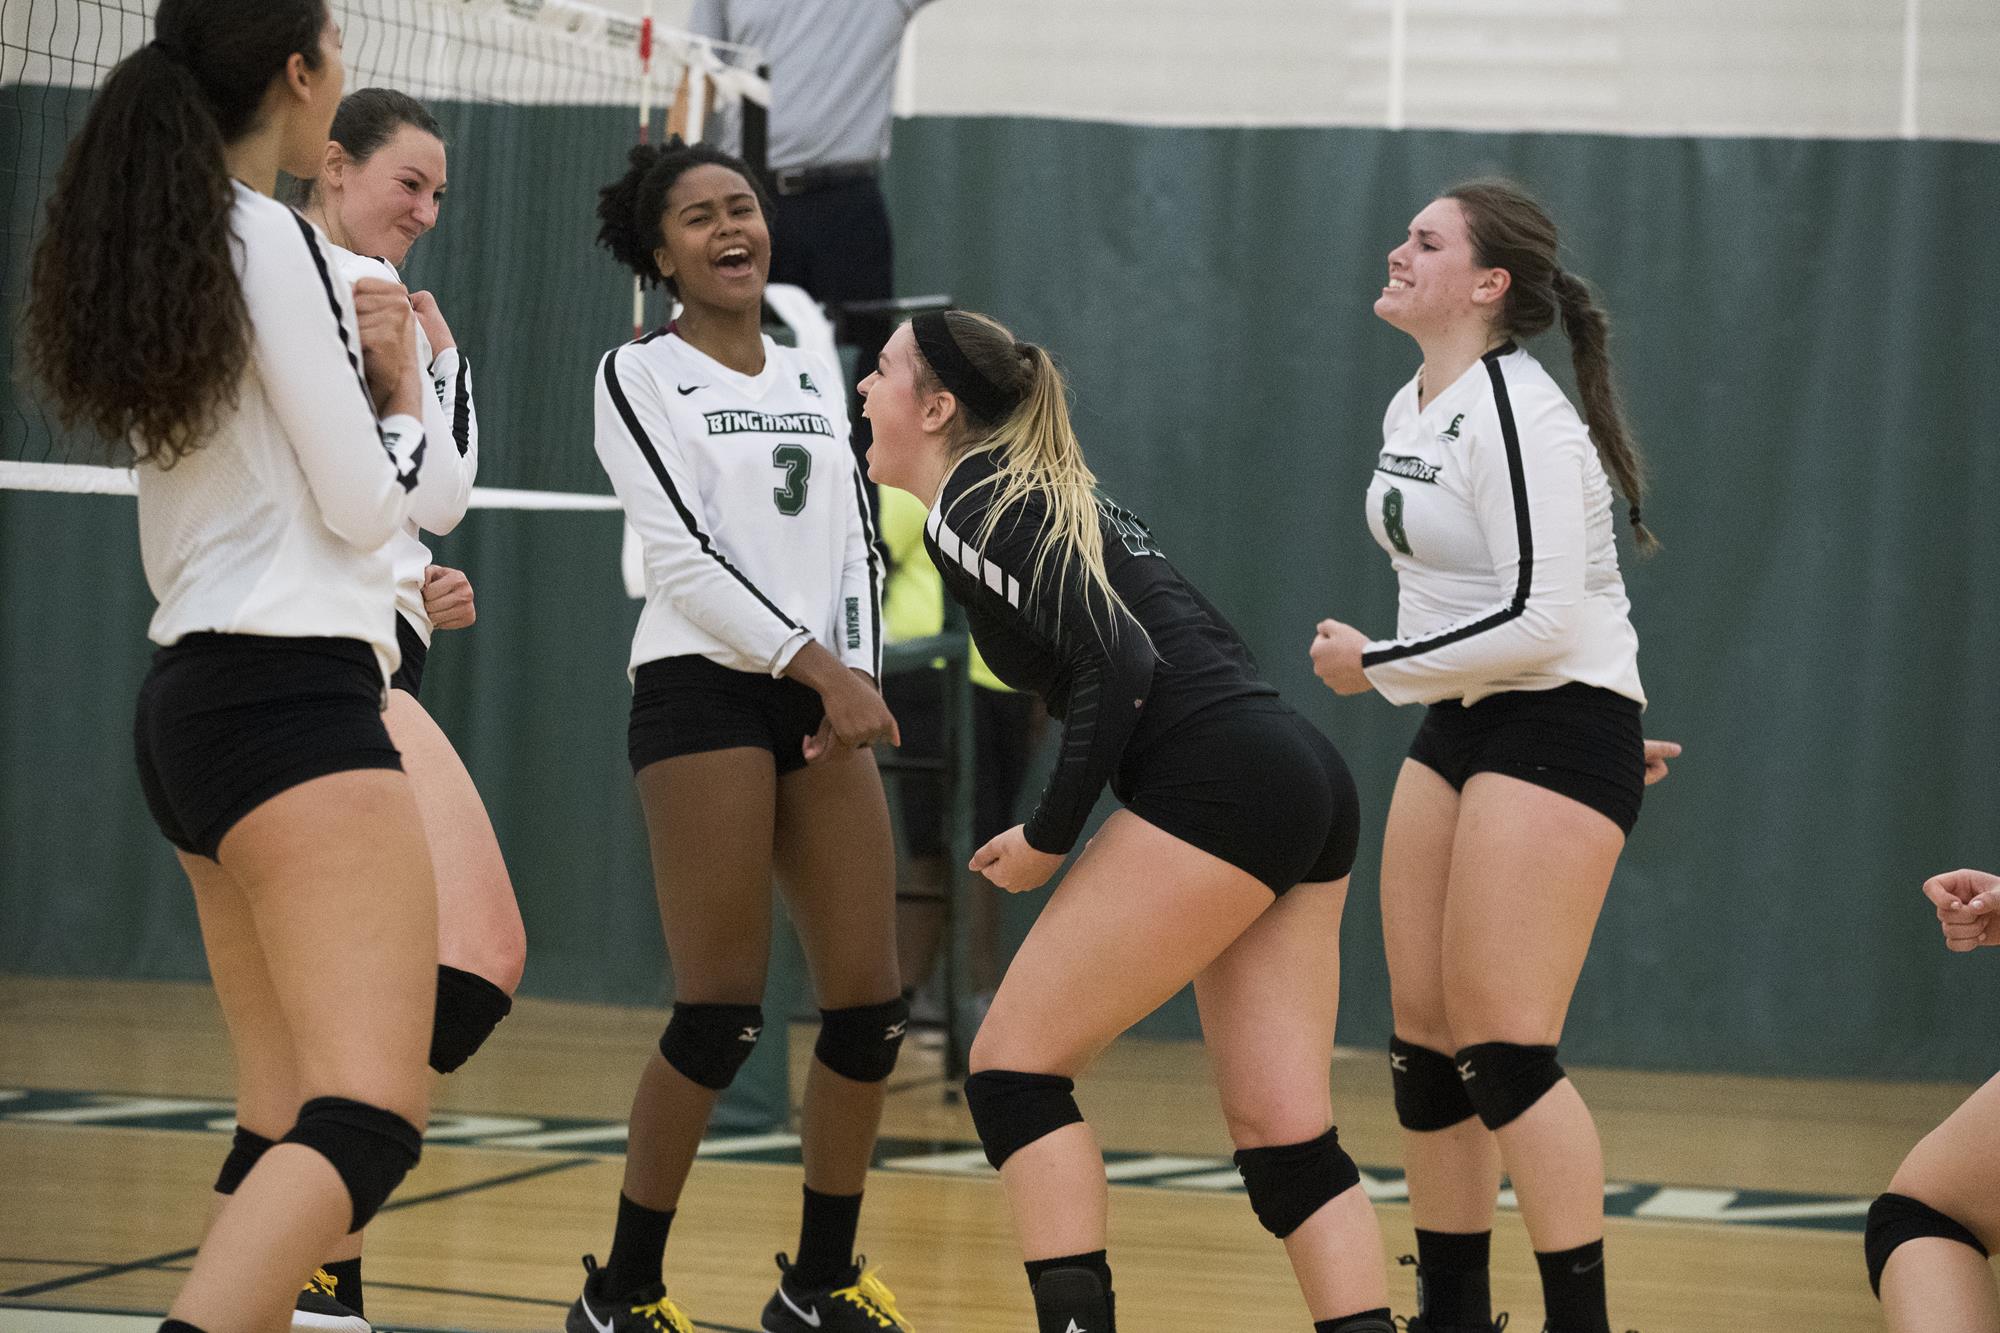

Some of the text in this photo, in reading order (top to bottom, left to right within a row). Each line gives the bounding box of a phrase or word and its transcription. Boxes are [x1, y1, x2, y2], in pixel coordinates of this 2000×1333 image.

[703, 410, 834, 438] BINGHAMTON
[773, 443, 812, 516] 3
[1382, 486, 1413, 556] 8
